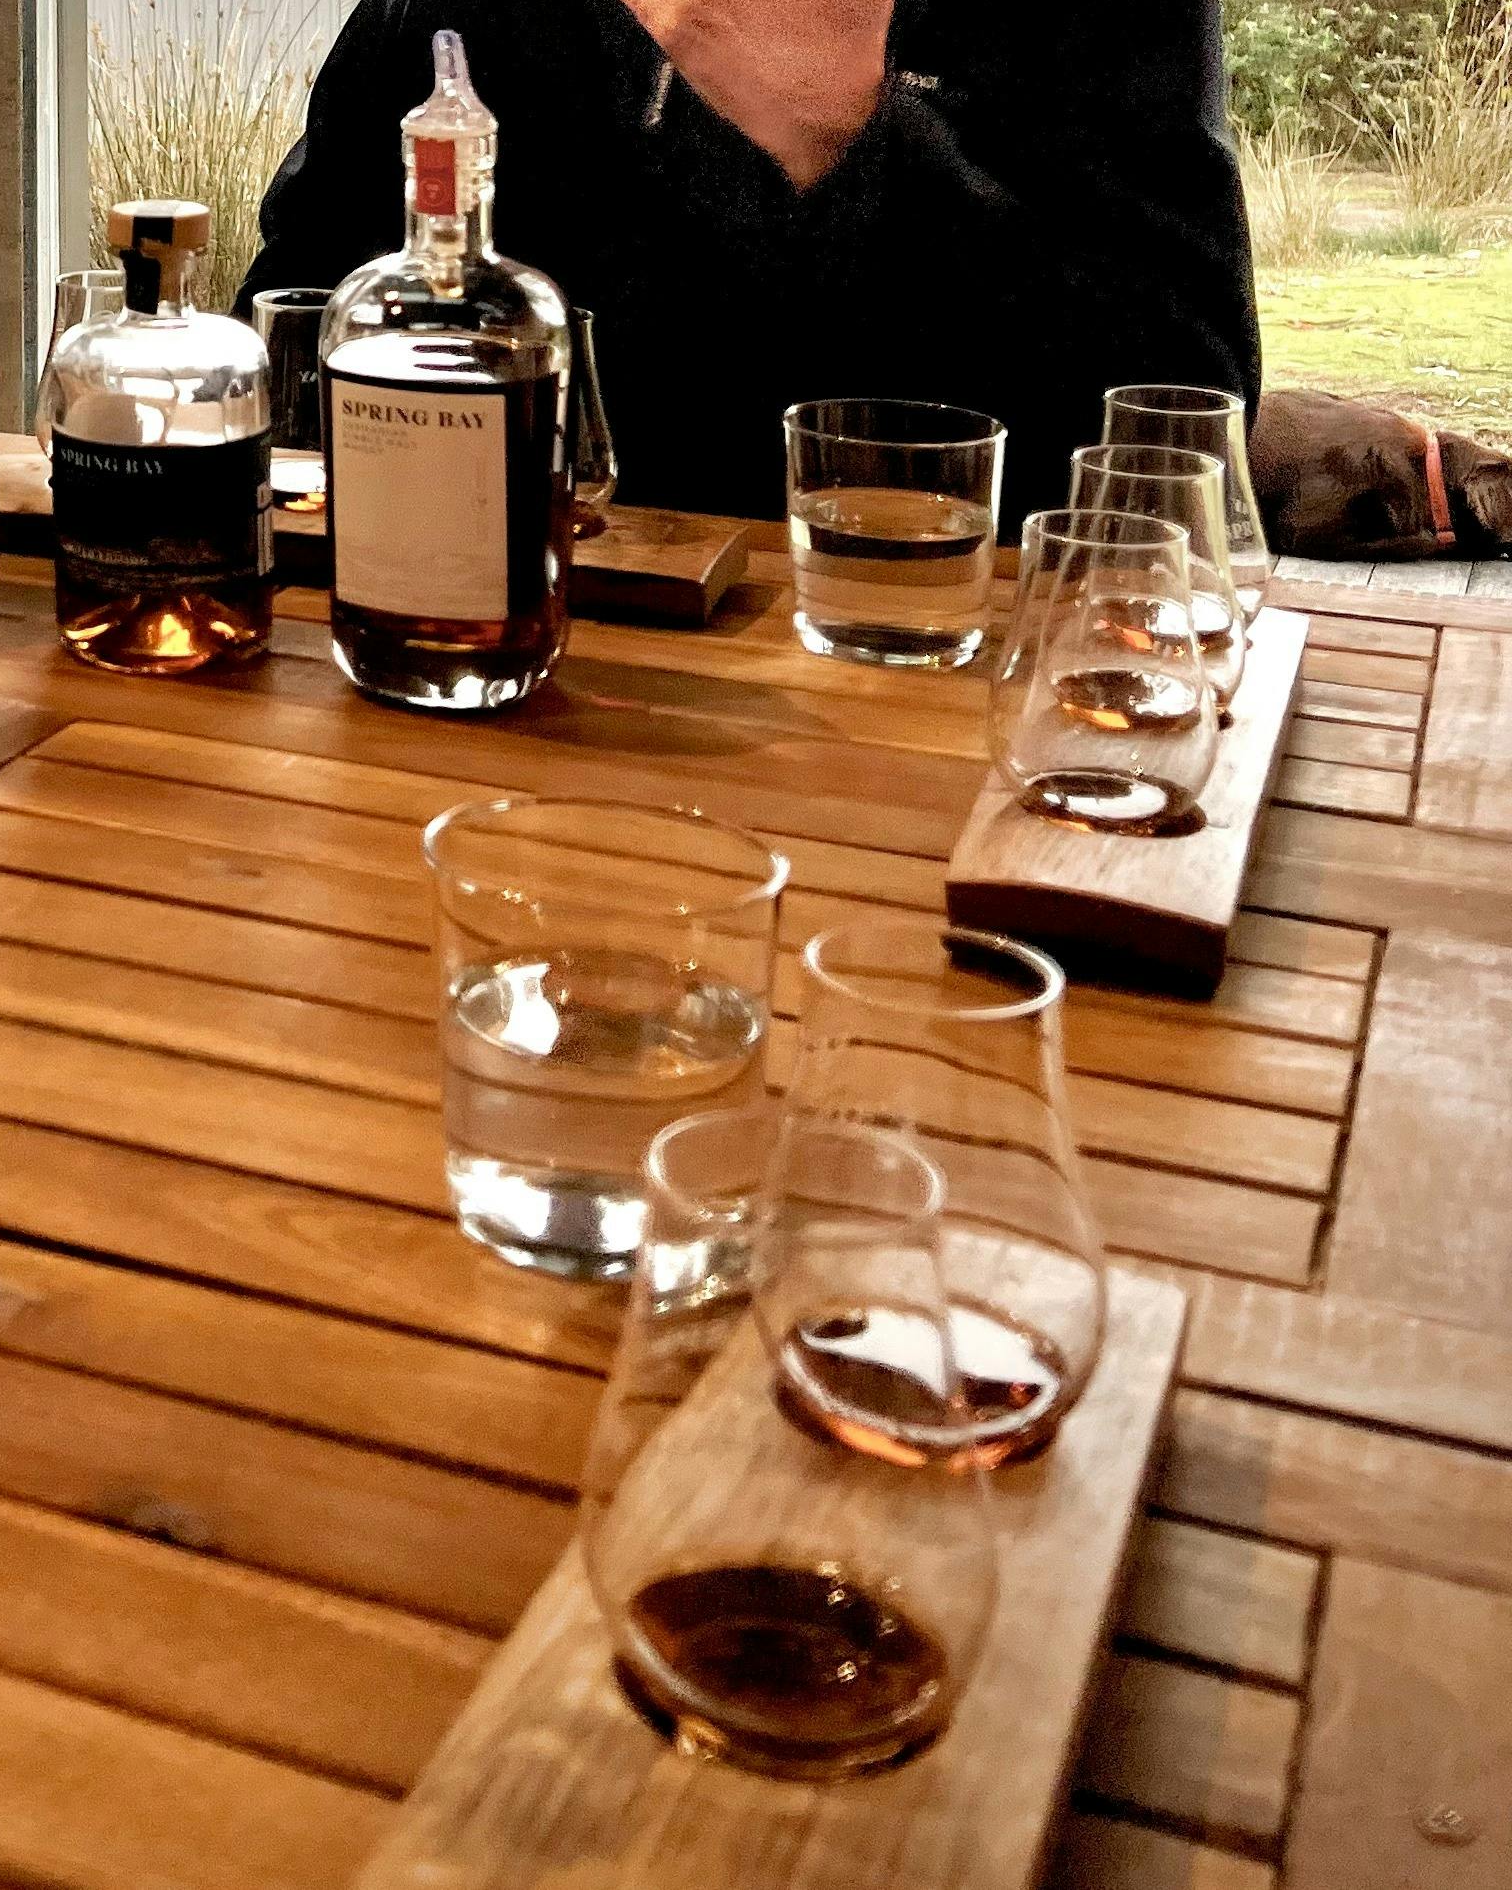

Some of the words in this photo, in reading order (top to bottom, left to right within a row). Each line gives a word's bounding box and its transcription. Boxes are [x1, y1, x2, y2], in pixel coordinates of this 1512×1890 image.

[342, 399, 428, 427] SPRING
[438, 411, 486, 430] BAY
[60, 448, 118, 473] SPRING
[126, 460, 165, 476] BAY
